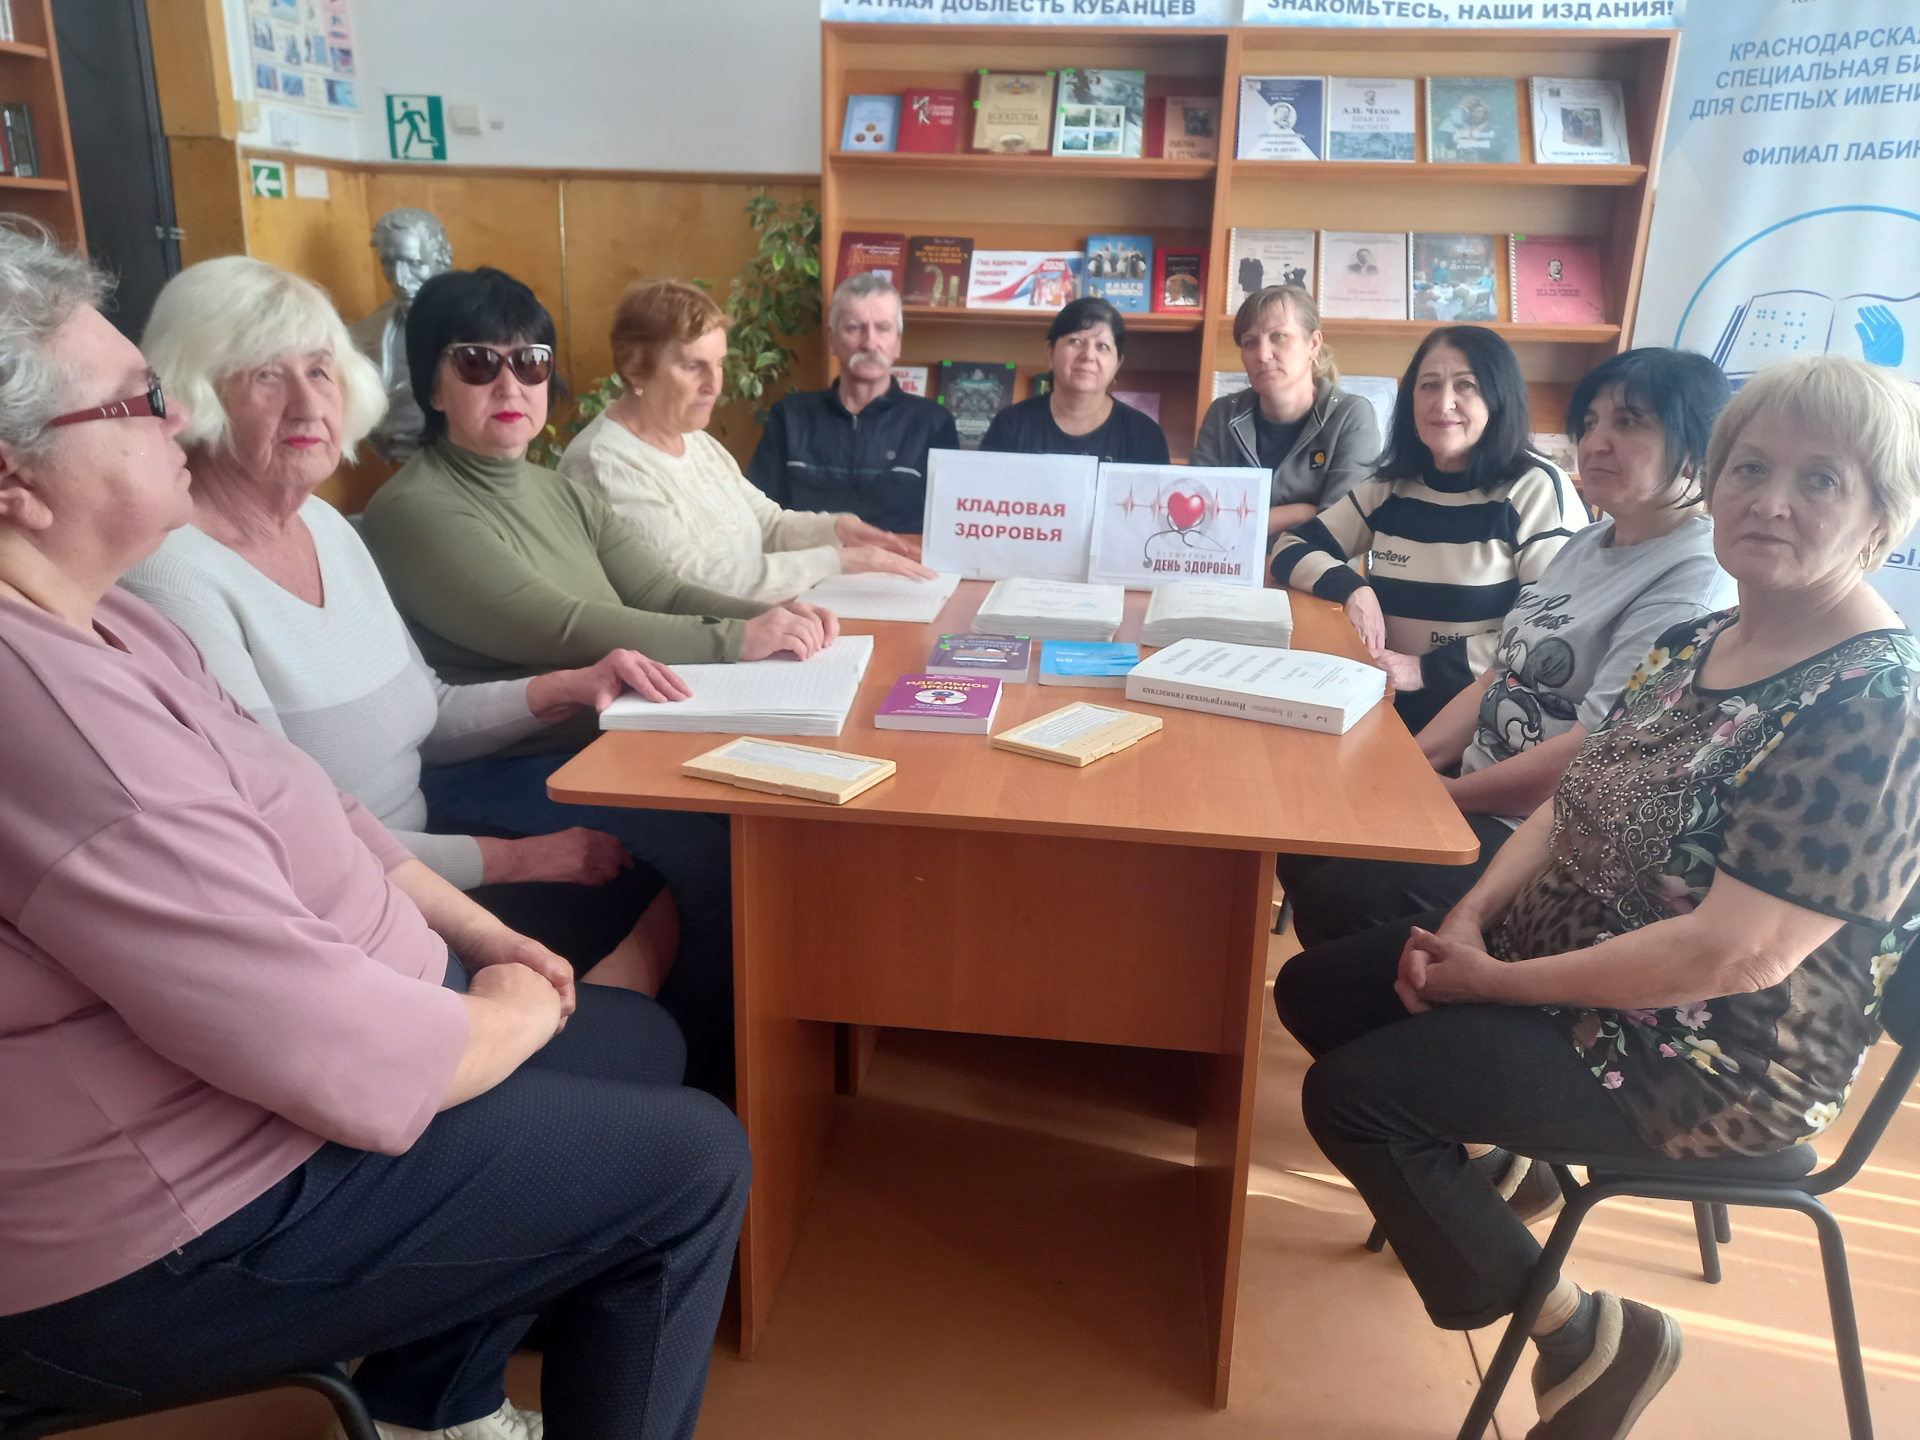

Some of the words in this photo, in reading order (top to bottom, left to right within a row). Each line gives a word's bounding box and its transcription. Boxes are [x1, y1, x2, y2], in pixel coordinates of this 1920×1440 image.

[843, 0, 933, 9] ТНАЯ
[941, 0, 1064, 13] ДОБЛЕСТЬ
[1073, 0, 1196, 17] КУБАНЦЕВ
[1267, 0, 1450, 22] ЗНАКОМЬТЕСЬ,
[1457, 3, 1533, 20] НАШИ
[1542, 1, 1675, 21] ИЗДАНИЯ!
[1729, 25, 1920, 62] КРАСНОДАРСКА
[1715, 55, 1889, 89] СПЕЦИАЛЬНАЯ
[1689, 96, 1735, 120] ДЛЯ
[1740, 88, 1838, 114] СЛЕПЫХ
[1742, 143, 1839, 166] ФИЛИАЛ
[956, 497, 1066, 518] КЛАДОВАЯ
[954, 522, 1063, 543] ЗДОРОВЬЯ
[1156, 550, 1213, 560] ВСЕМИРНЫЙ
[1153, 558, 1181, 573] ДЕНЬ
[1184, 560, 1242, 576] ЗДОРОВЬЯ
[905, 680, 989, 689] ИДЕАЛЬНОЕ
[919, 684, 971, 692] ЗРЕНИЕ
[1142, 687, 1184, 699] гимнастика
[1186, 694, 1246, 711] Изометрическая
